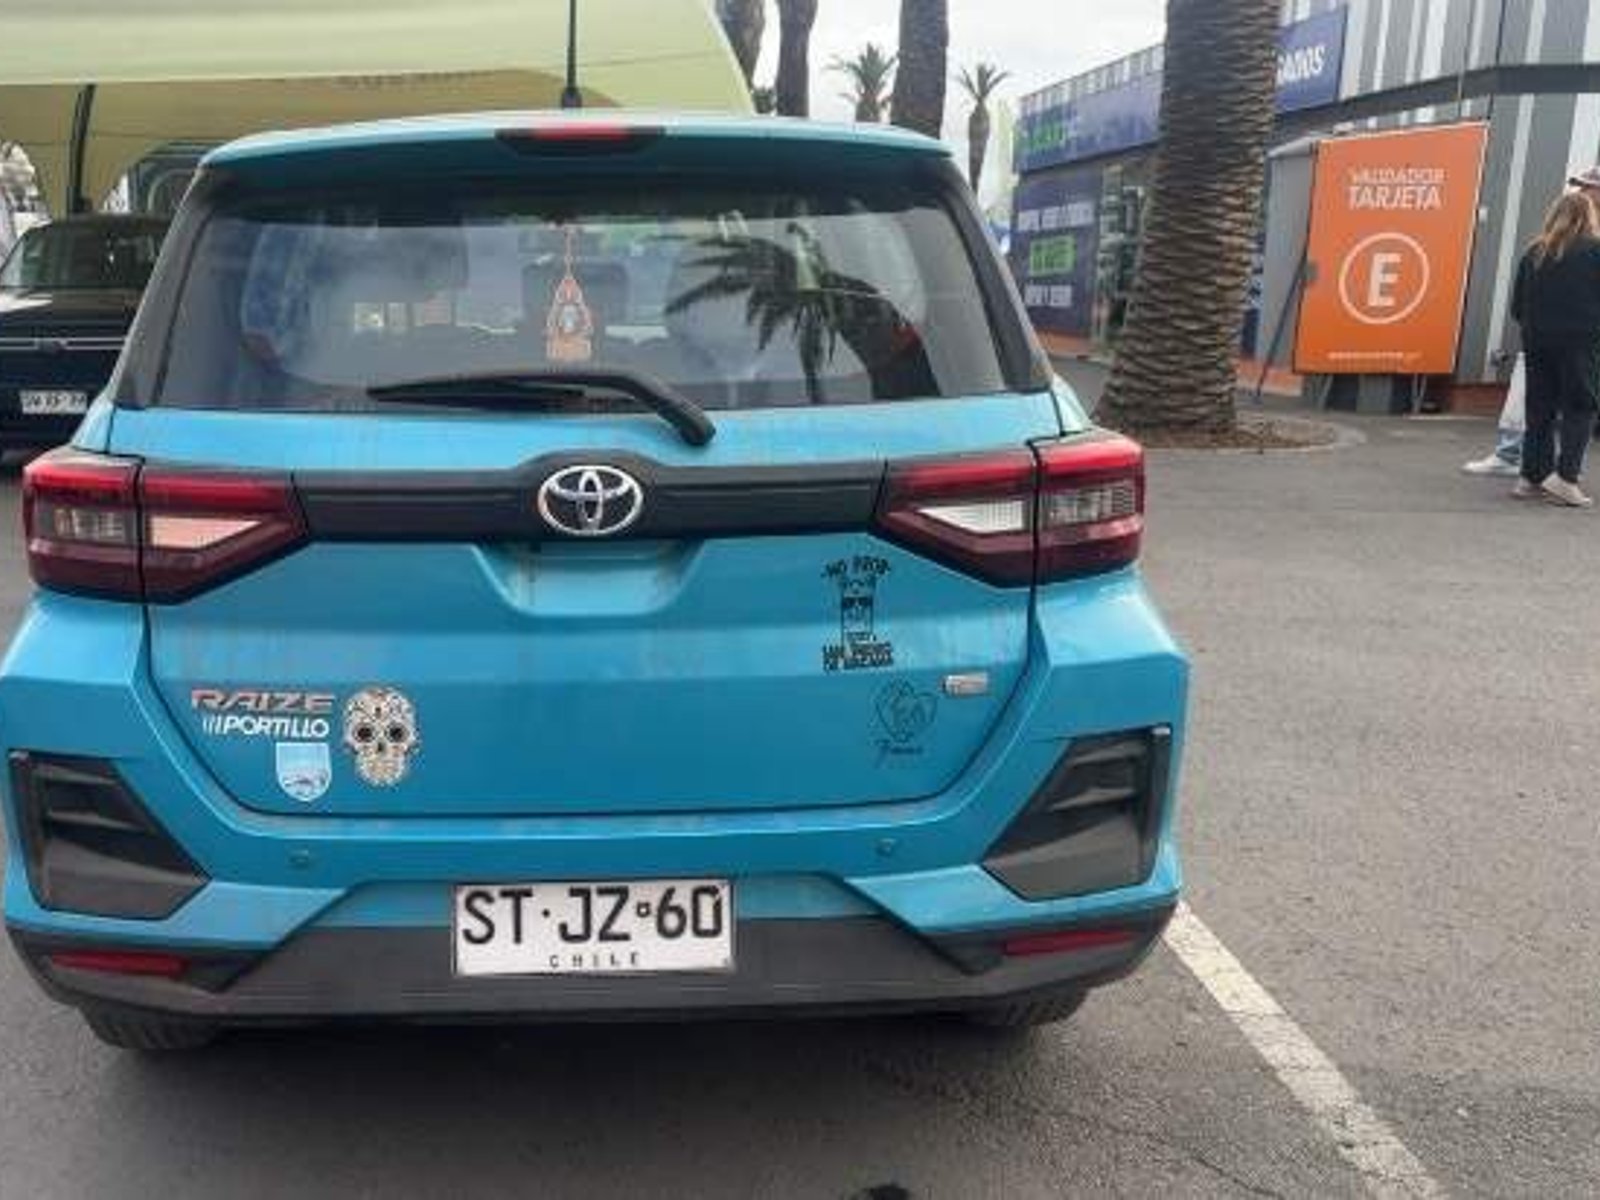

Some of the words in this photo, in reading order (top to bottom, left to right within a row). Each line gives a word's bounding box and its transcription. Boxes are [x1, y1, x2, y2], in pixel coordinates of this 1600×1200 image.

[1348, 185, 1443, 211] TARJETA
[1367, 251, 1404, 308] E
[191, 689, 336, 714] RAIZE
[549, 952, 642, 968] CHILE
